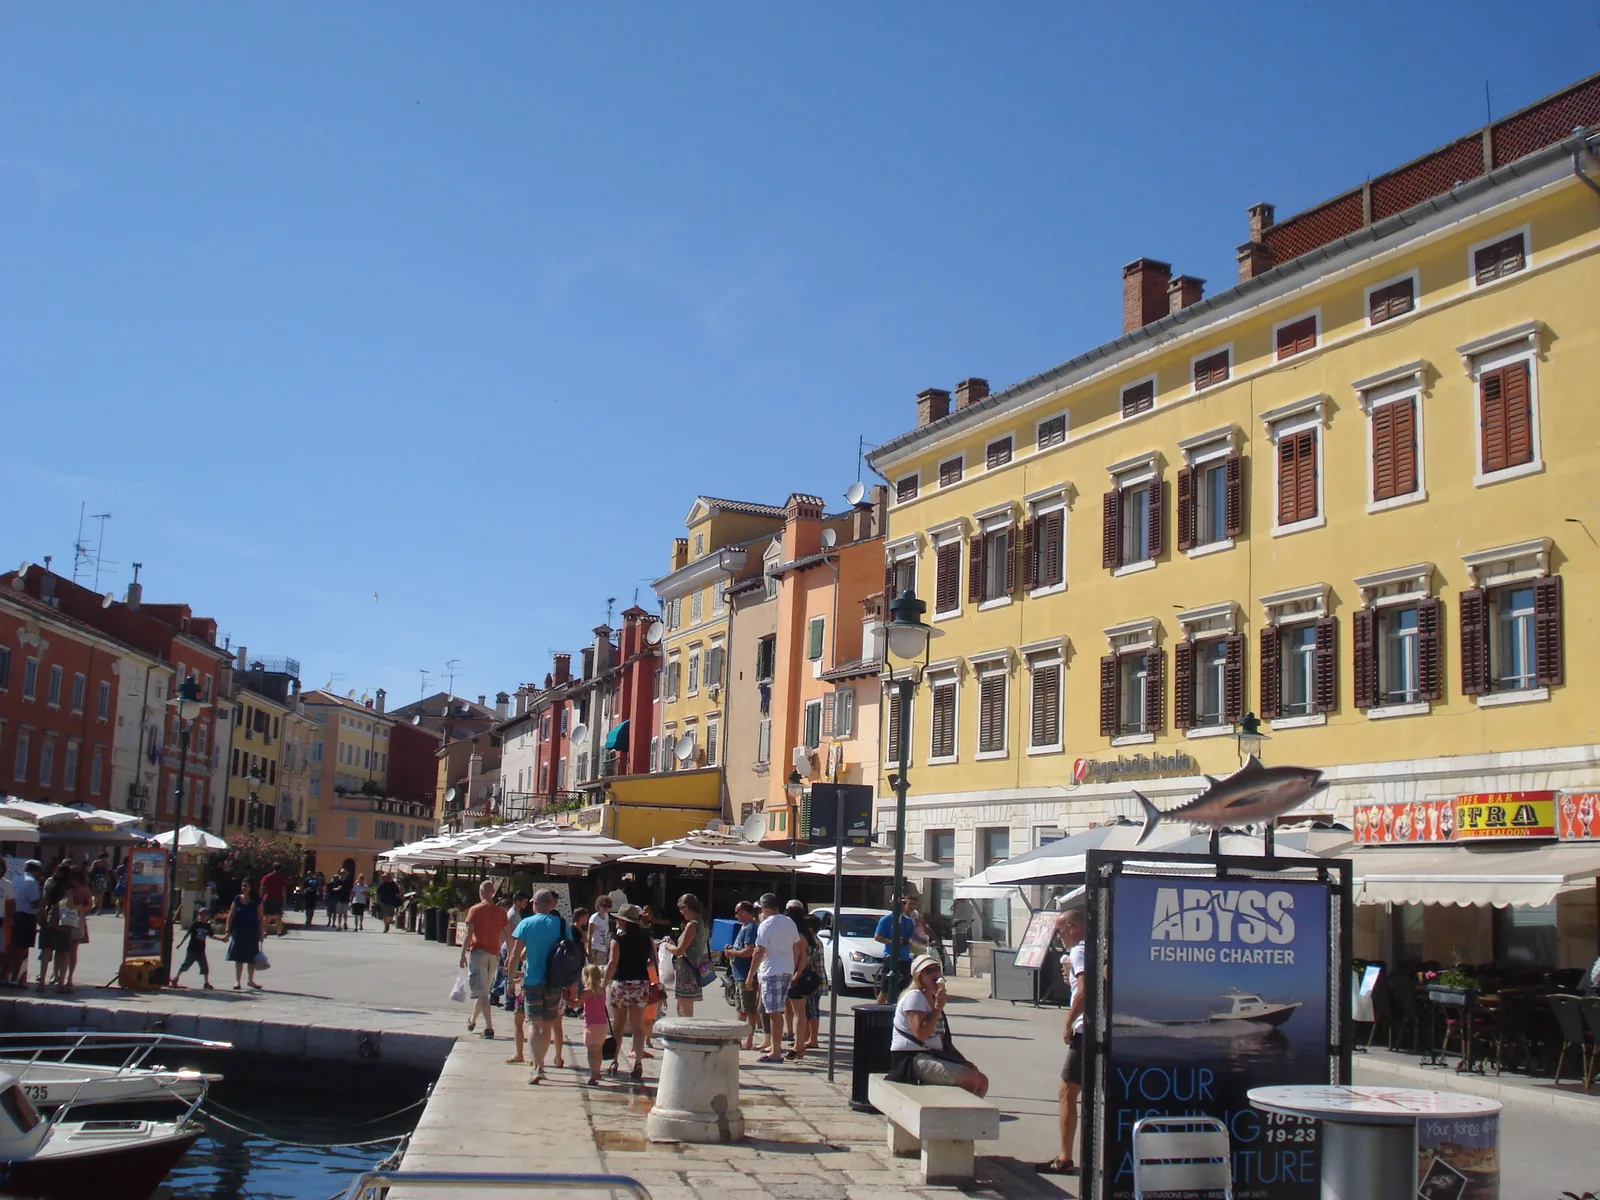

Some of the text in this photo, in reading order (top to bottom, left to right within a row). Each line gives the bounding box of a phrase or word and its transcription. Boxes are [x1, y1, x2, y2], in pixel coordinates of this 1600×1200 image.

[1153, 749, 1193, 771] banka
[1487, 793, 1513, 803] BAR
[1151, 888, 1295, 945] ABYSS
[1151, 946, 1295, 965] FISHING CHARTER
[1117, 1067, 1214, 1101] YOUR
[1266, 1129, 1316, 1143] 19-23
